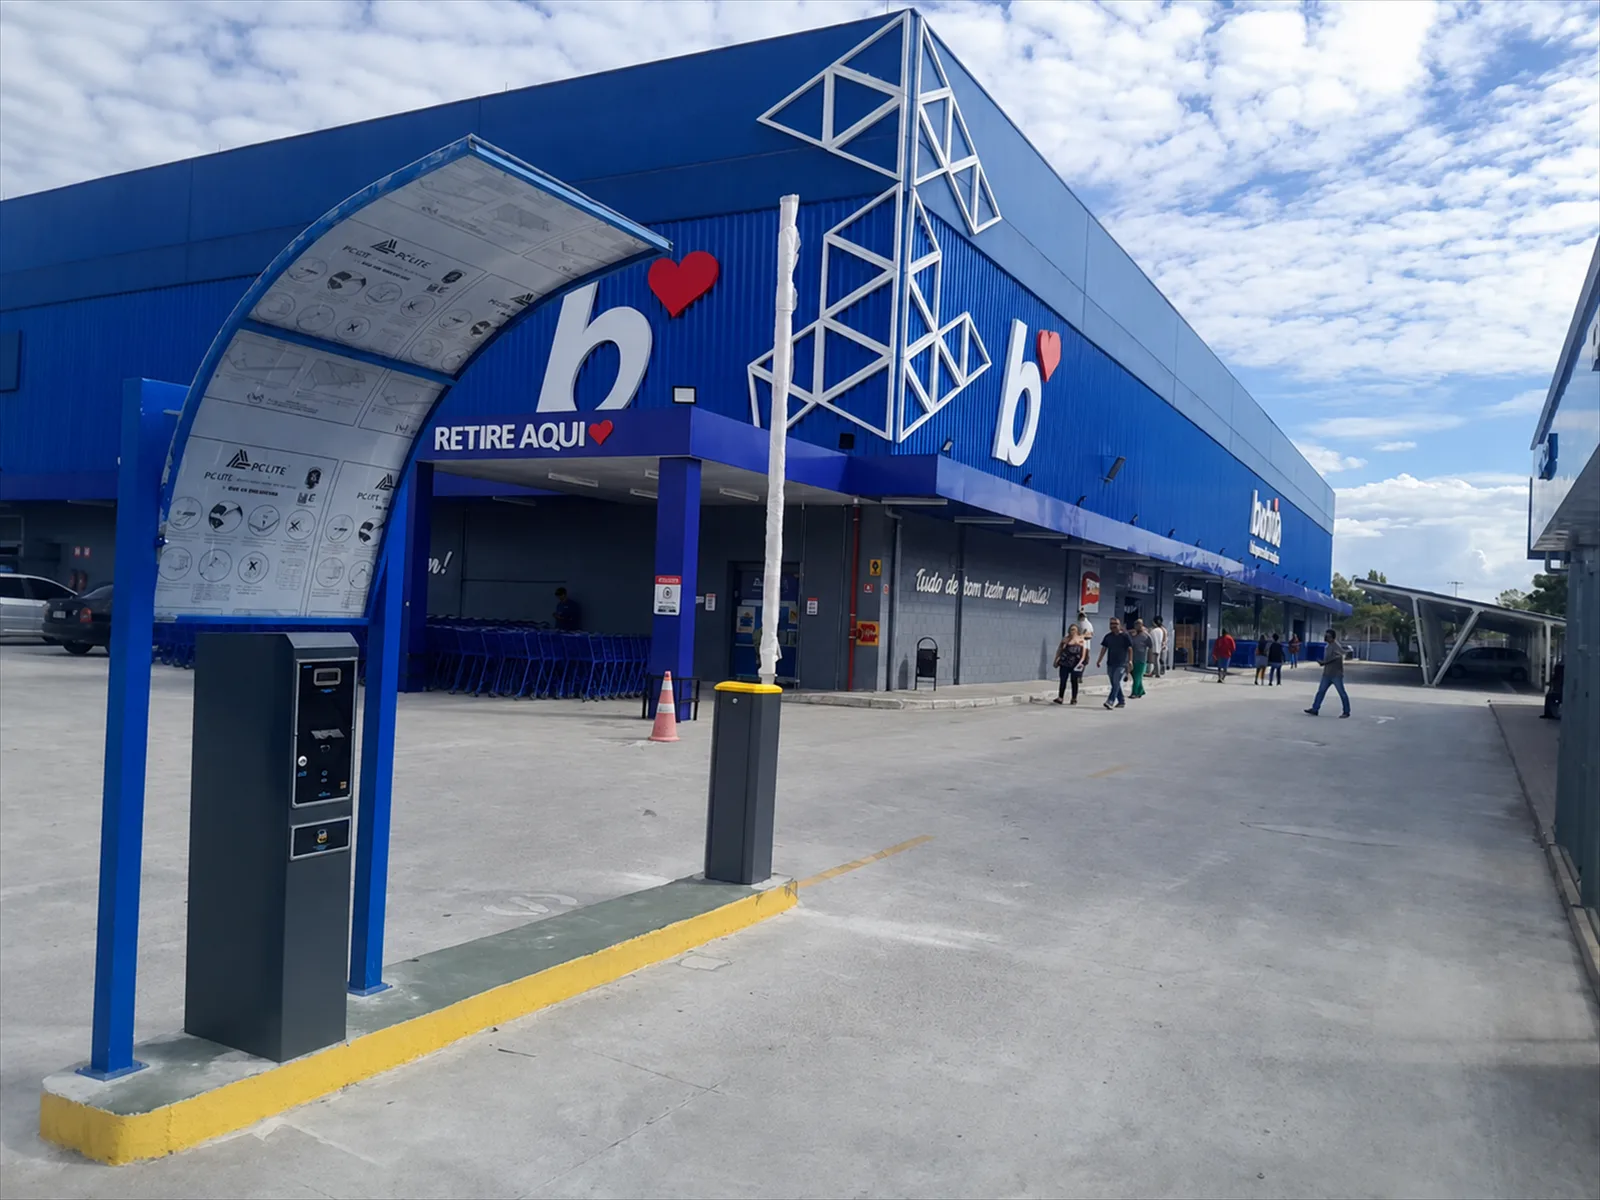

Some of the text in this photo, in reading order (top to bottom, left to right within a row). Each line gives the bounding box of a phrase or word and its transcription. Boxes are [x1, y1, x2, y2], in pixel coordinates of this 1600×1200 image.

[992, 318, 1042, 466] b
[434, 421, 586, 451] RETIRE AQUI
[916, 568, 943, 593] Tudo
[945, 573, 959, 595] de
